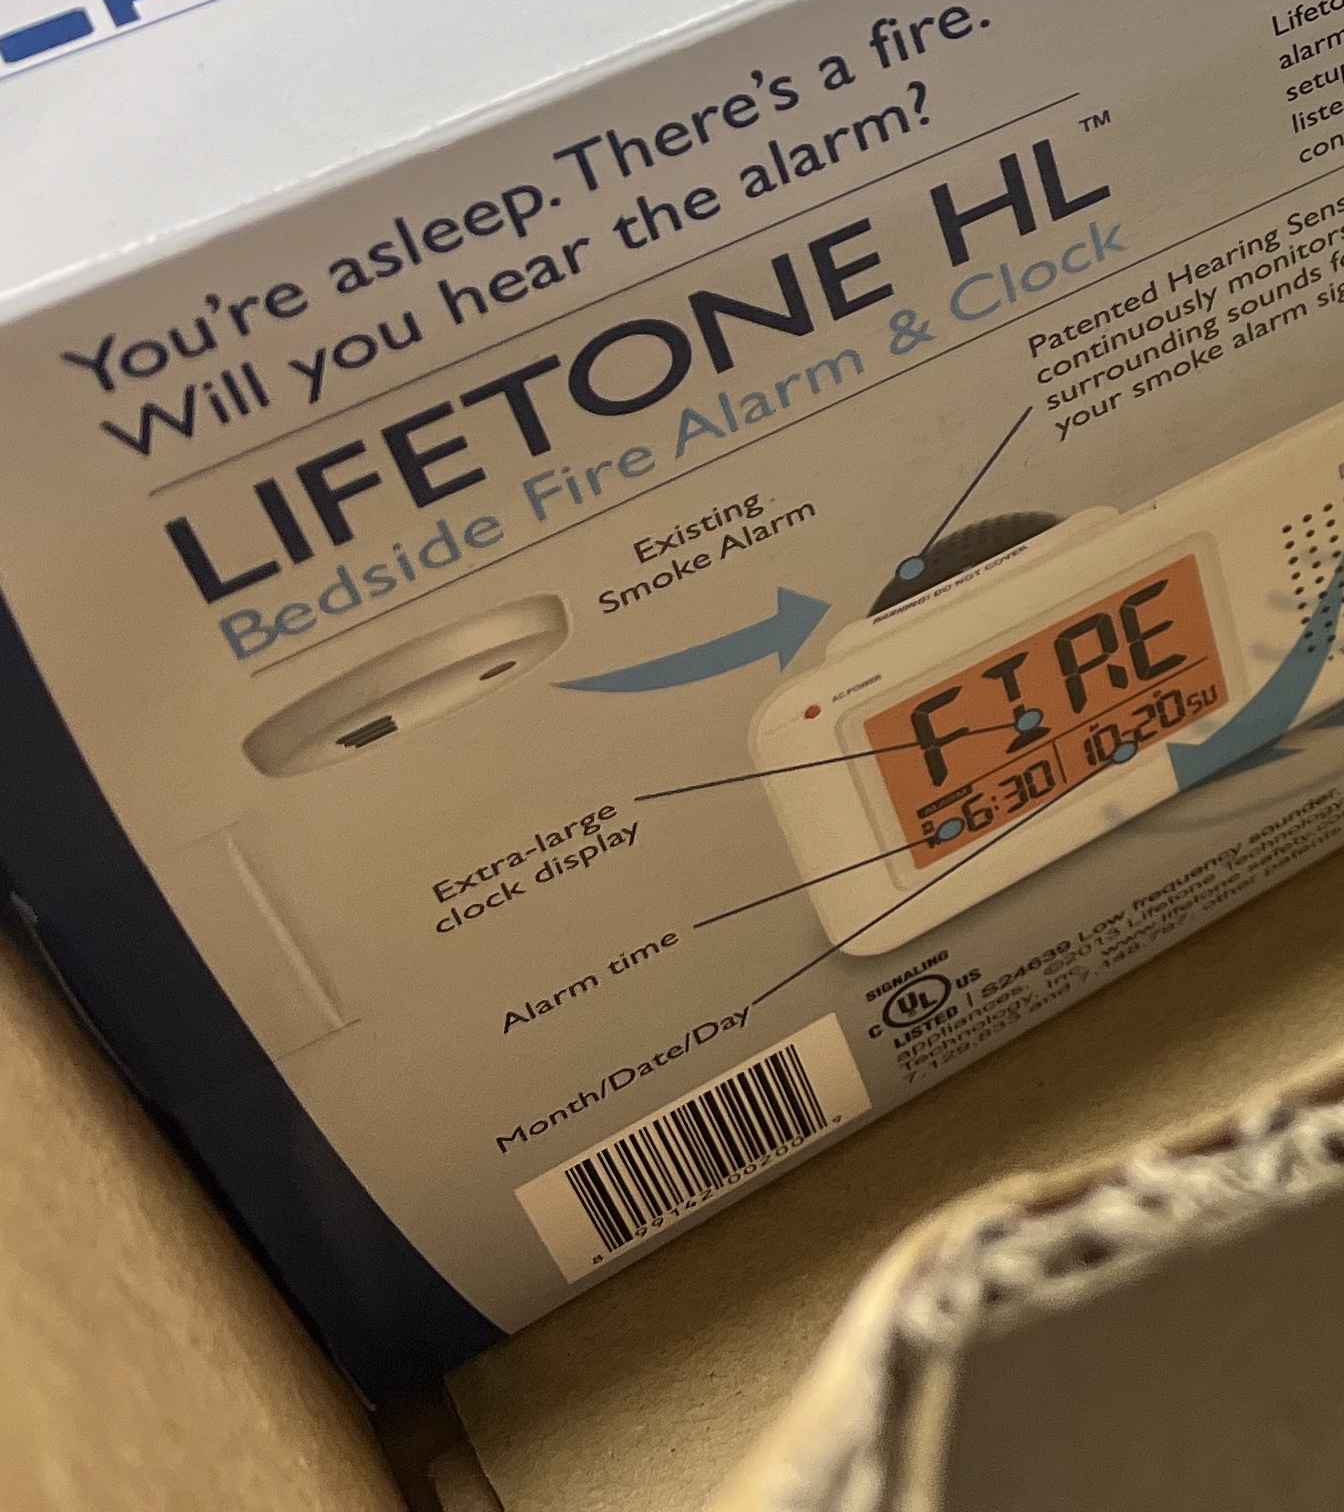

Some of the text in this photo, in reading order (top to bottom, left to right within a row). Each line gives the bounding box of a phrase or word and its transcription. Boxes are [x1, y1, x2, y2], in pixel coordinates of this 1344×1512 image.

[328, 184, 561, 294] asleep.
[818, 55, 856, 90] a
[869, 6, 991, 69] fire.
[100, 80, 930, 456] Will you hear the alarm?
[1027, 279, 1158, 358] Patented
[1167, 228, 1281, 293] Hearing
[1036, 286, 1217, 384] continuously
[1046, 315, 1220, 411] surrounding
[1226, 266, 1322, 323] sounds
[1054, 391, 1122, 442] your
[1132, 344, 1224, 398] smoke
[1232, 302, 1307, 349] alarm
[164, 217, 894, 604] LIFETONE
[220, 224, 1122, 660] Bedside Fire Alarm & Clock
[598, 503, 816, 614] Smoke Alarm
[632, 493, 764, 564] Existing
[910, 579, 1188, 787] FIRE
[961, 759, 1057, 833] 6:30
[1186, 685, 1219, 715] SU
[431, 805, 617, 904] Extra-large
[435, 821, 638, 933] clock display
[503, 932, 679, 1034] Alarm time
[865, 949, 949, 1003] SIGNALING
[893, 1006, 959, 1048] LISTED
[896, 990, 938, 1018] UL
[955, 968, 983, 990] US
[495, 1005, 749, 1154] Month/Date/Day
